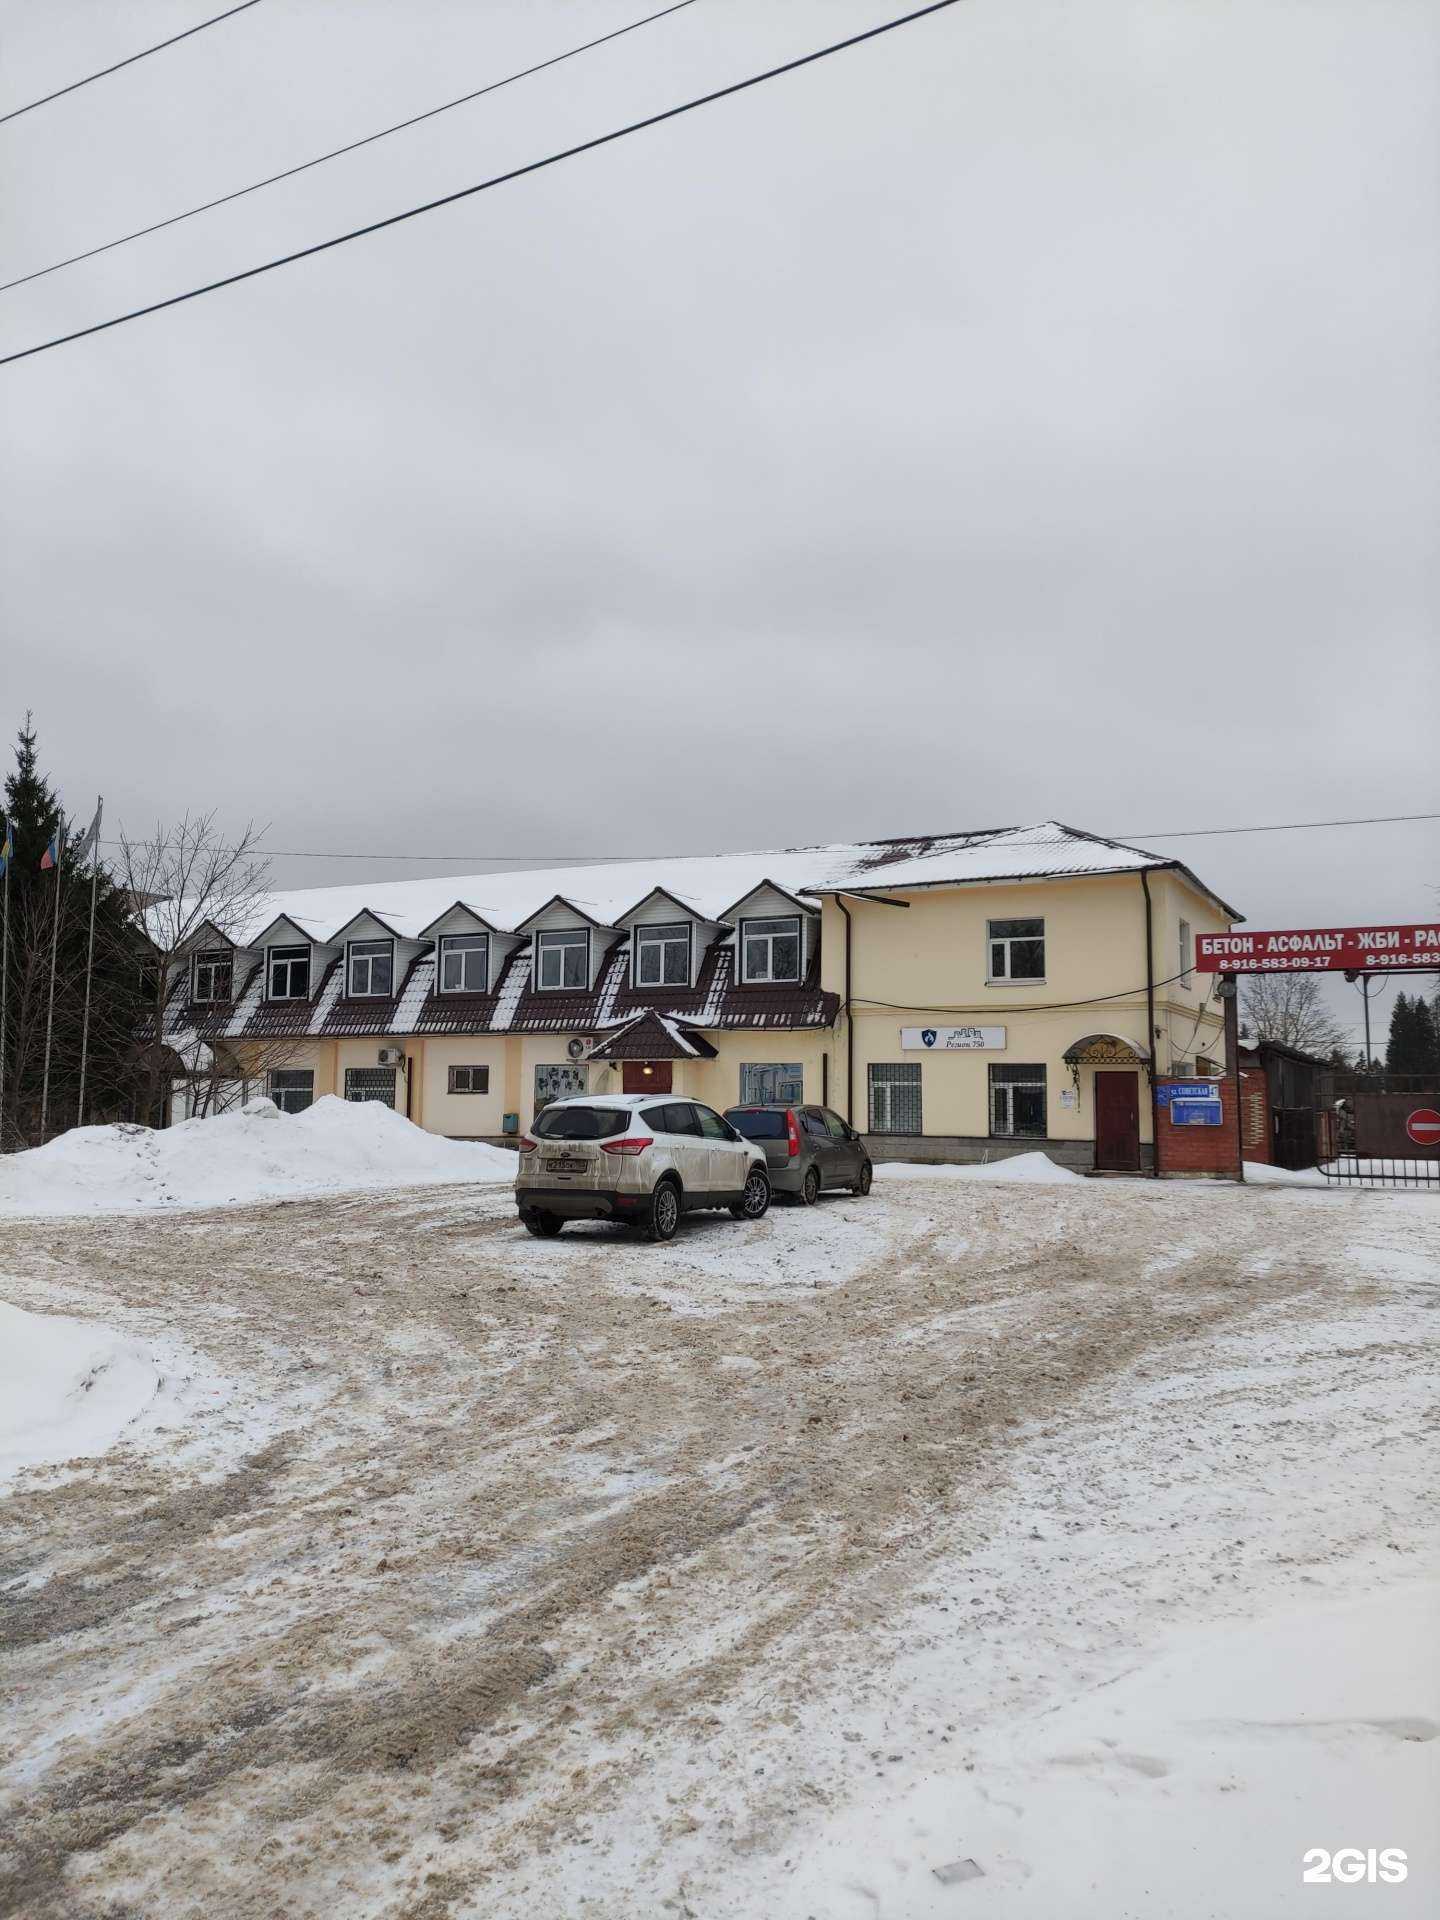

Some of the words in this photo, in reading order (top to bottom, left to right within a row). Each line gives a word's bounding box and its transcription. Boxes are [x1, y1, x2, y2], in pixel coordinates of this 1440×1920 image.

[1202, 937, 1254, 955] БЕТОН
[1267, 933, 1345, 953] АСФАЛЬТ
[1358, 931, 1400, 949] ЖБИ
[1415, 929, 1440, 948] РА
[1219, 956, 1331, 970] 8-916-583-09-17
